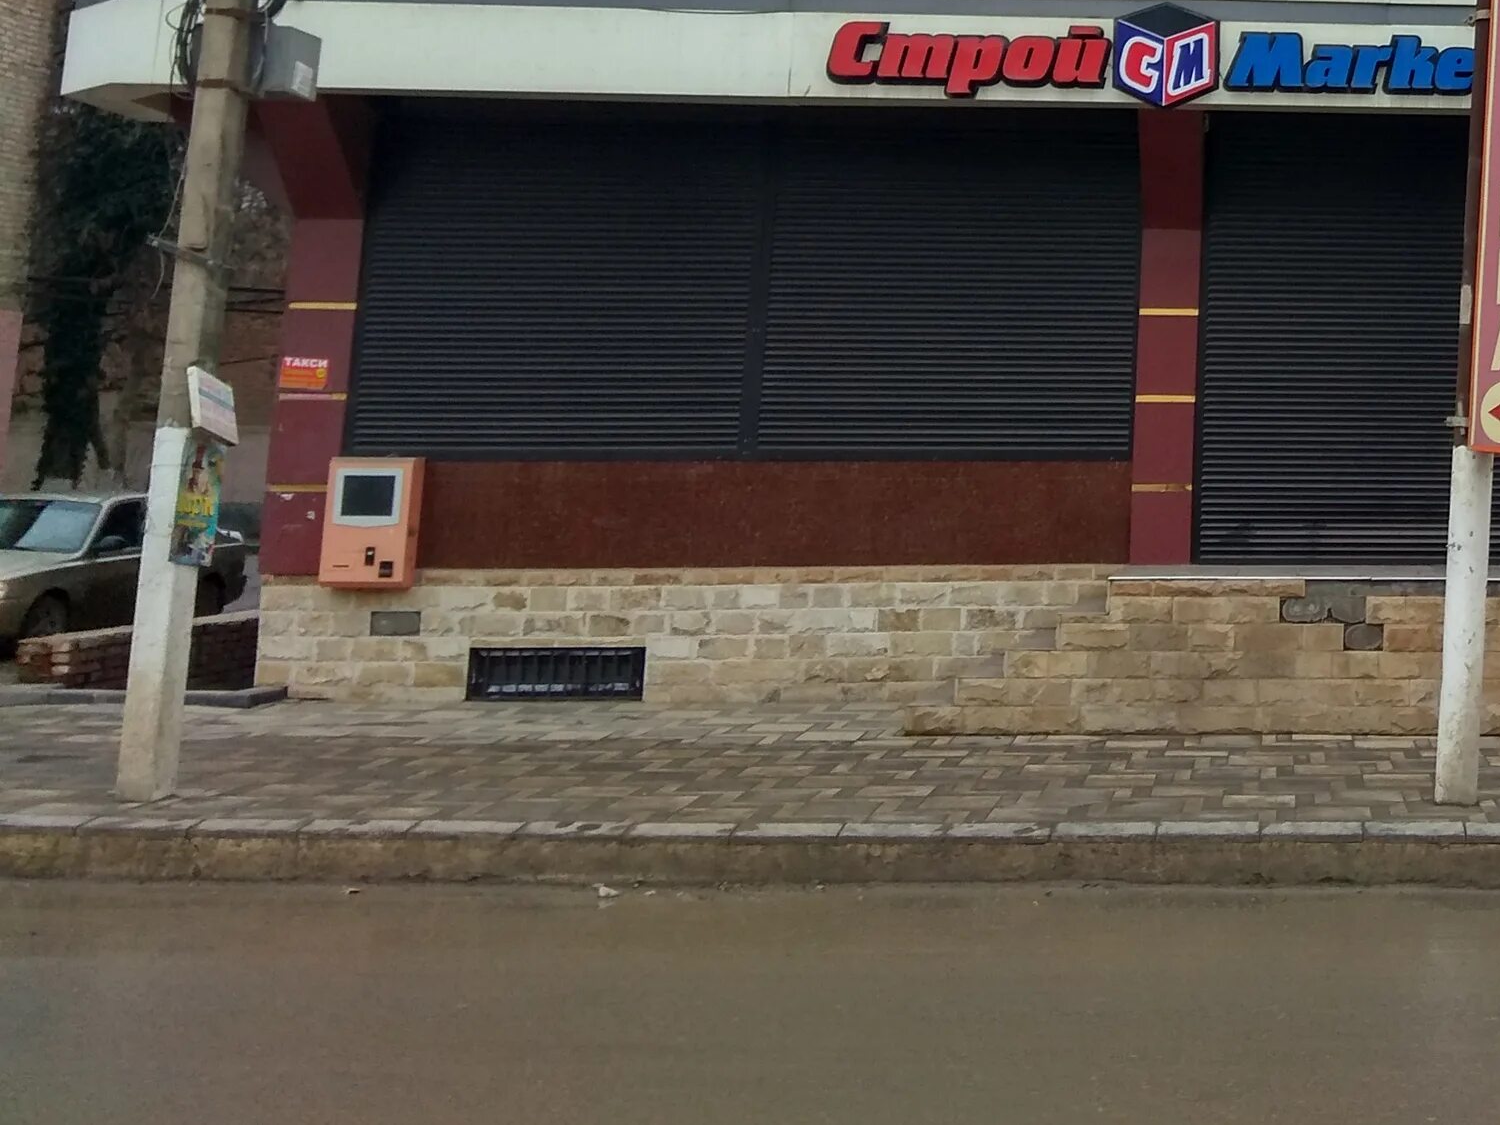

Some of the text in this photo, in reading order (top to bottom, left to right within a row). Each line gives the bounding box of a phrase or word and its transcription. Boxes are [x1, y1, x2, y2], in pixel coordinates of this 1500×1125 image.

[825, 20, 1112, 98] Строй
[1223, 29, 1476, 96] Marke
[283, 356, 329, 369] ТАКСИ
